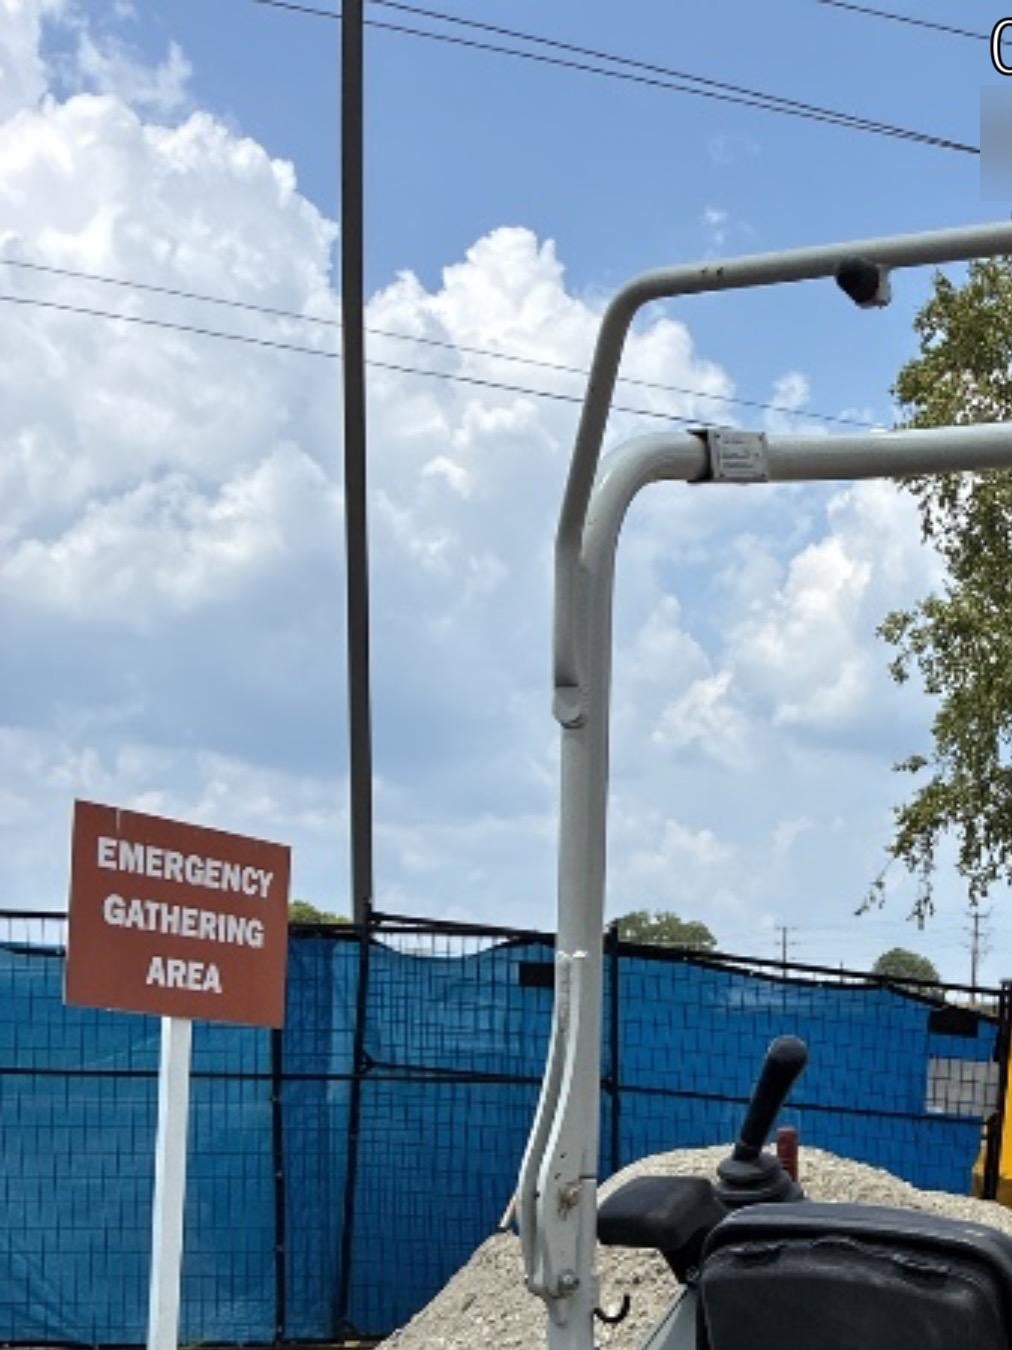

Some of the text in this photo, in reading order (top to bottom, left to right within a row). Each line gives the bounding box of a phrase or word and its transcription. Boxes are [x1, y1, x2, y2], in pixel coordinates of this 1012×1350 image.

[97, 836, 274, 899] EMERGENCY
[104, 894, 265, 949] GATHERING
[146, 956, 223, 994] AREA
